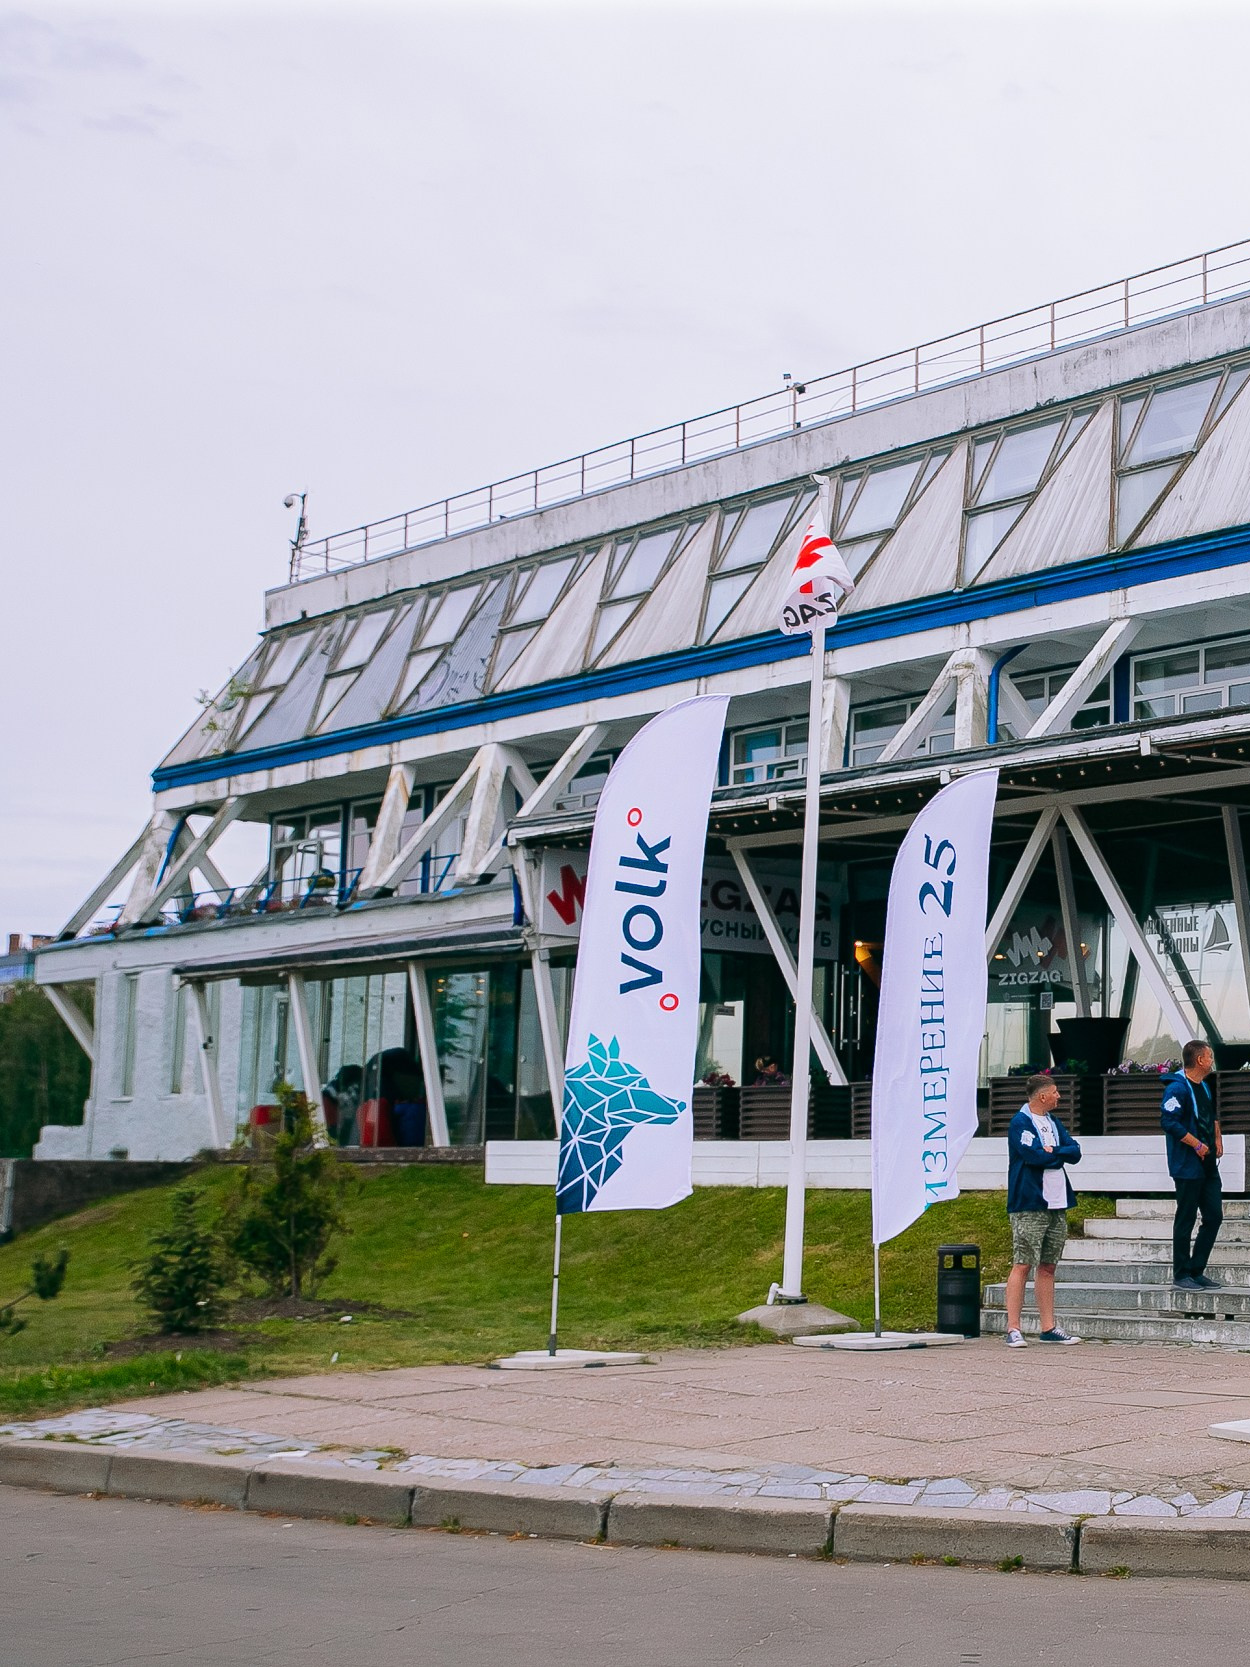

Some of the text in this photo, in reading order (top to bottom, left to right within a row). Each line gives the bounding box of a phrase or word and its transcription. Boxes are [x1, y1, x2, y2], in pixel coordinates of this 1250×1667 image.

[614, 831, 672, 995] volk
[998, 970, 1062, 986] ZIGZAG
[919, 833, 957, 1210] ИЗМЕРЕНИЕ 25
